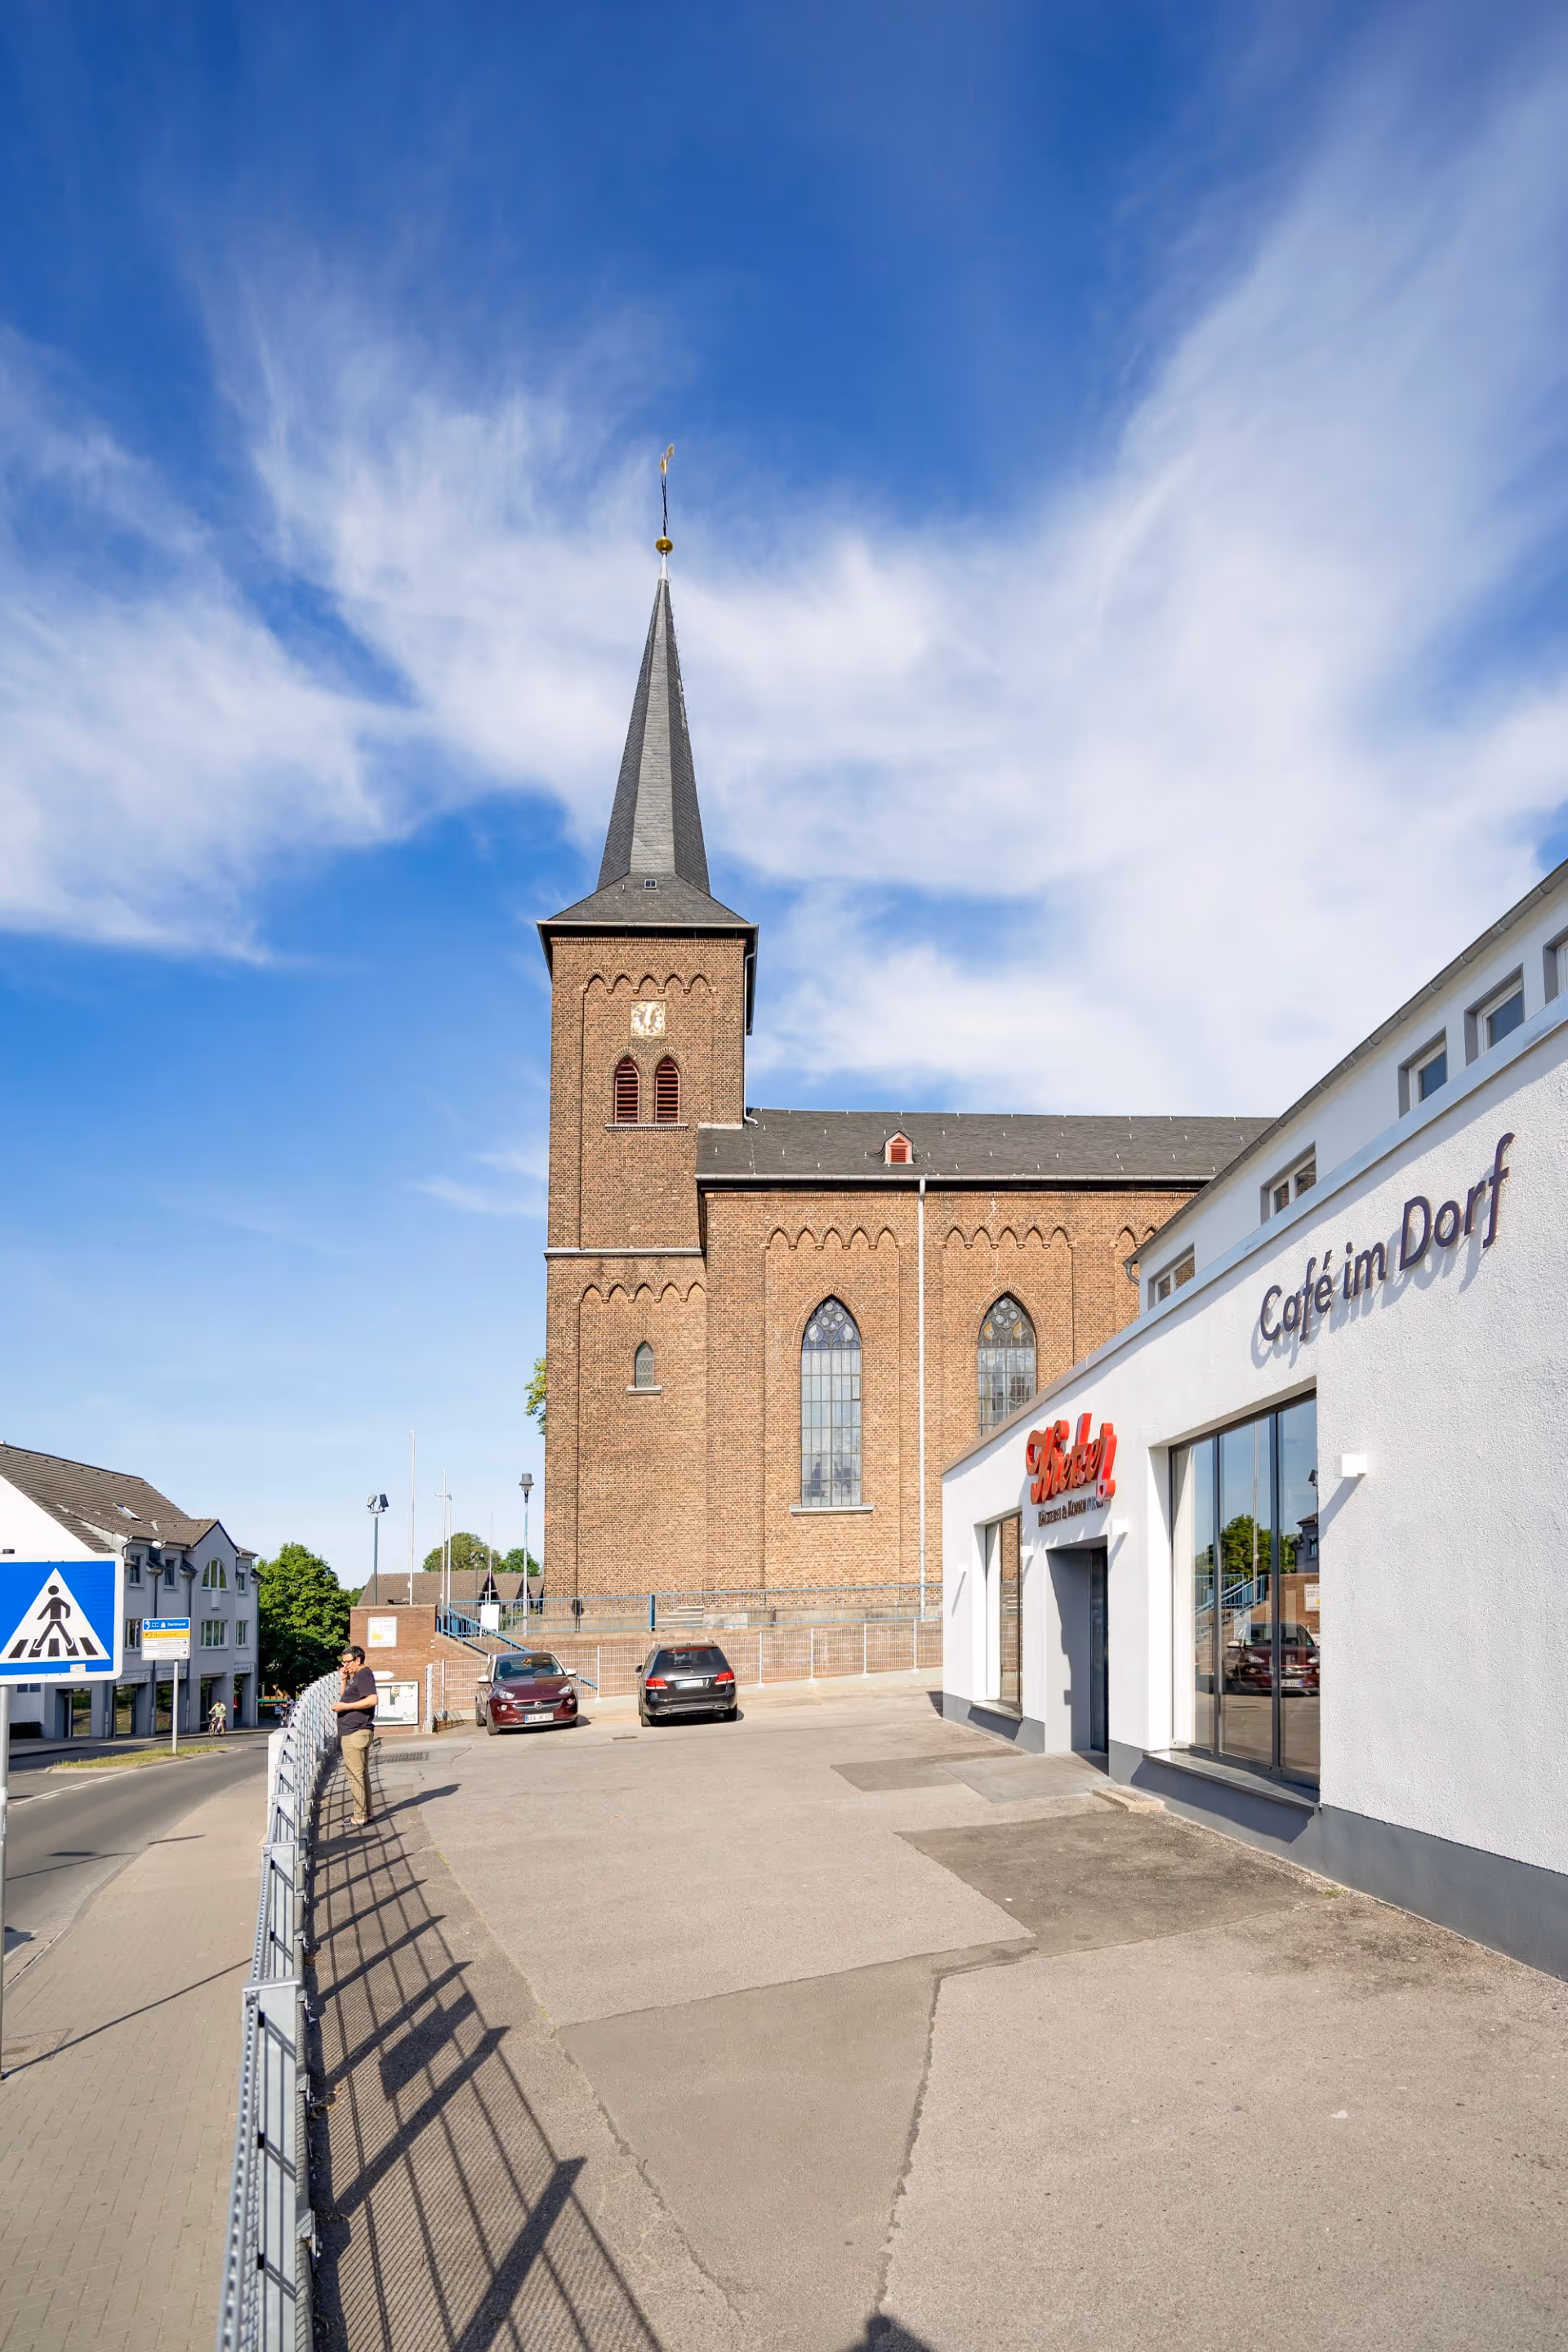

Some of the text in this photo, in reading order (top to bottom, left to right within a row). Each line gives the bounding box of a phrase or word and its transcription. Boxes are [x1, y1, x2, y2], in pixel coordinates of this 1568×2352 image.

[1259, 1132, 1516, 1342] Café im Dorf
